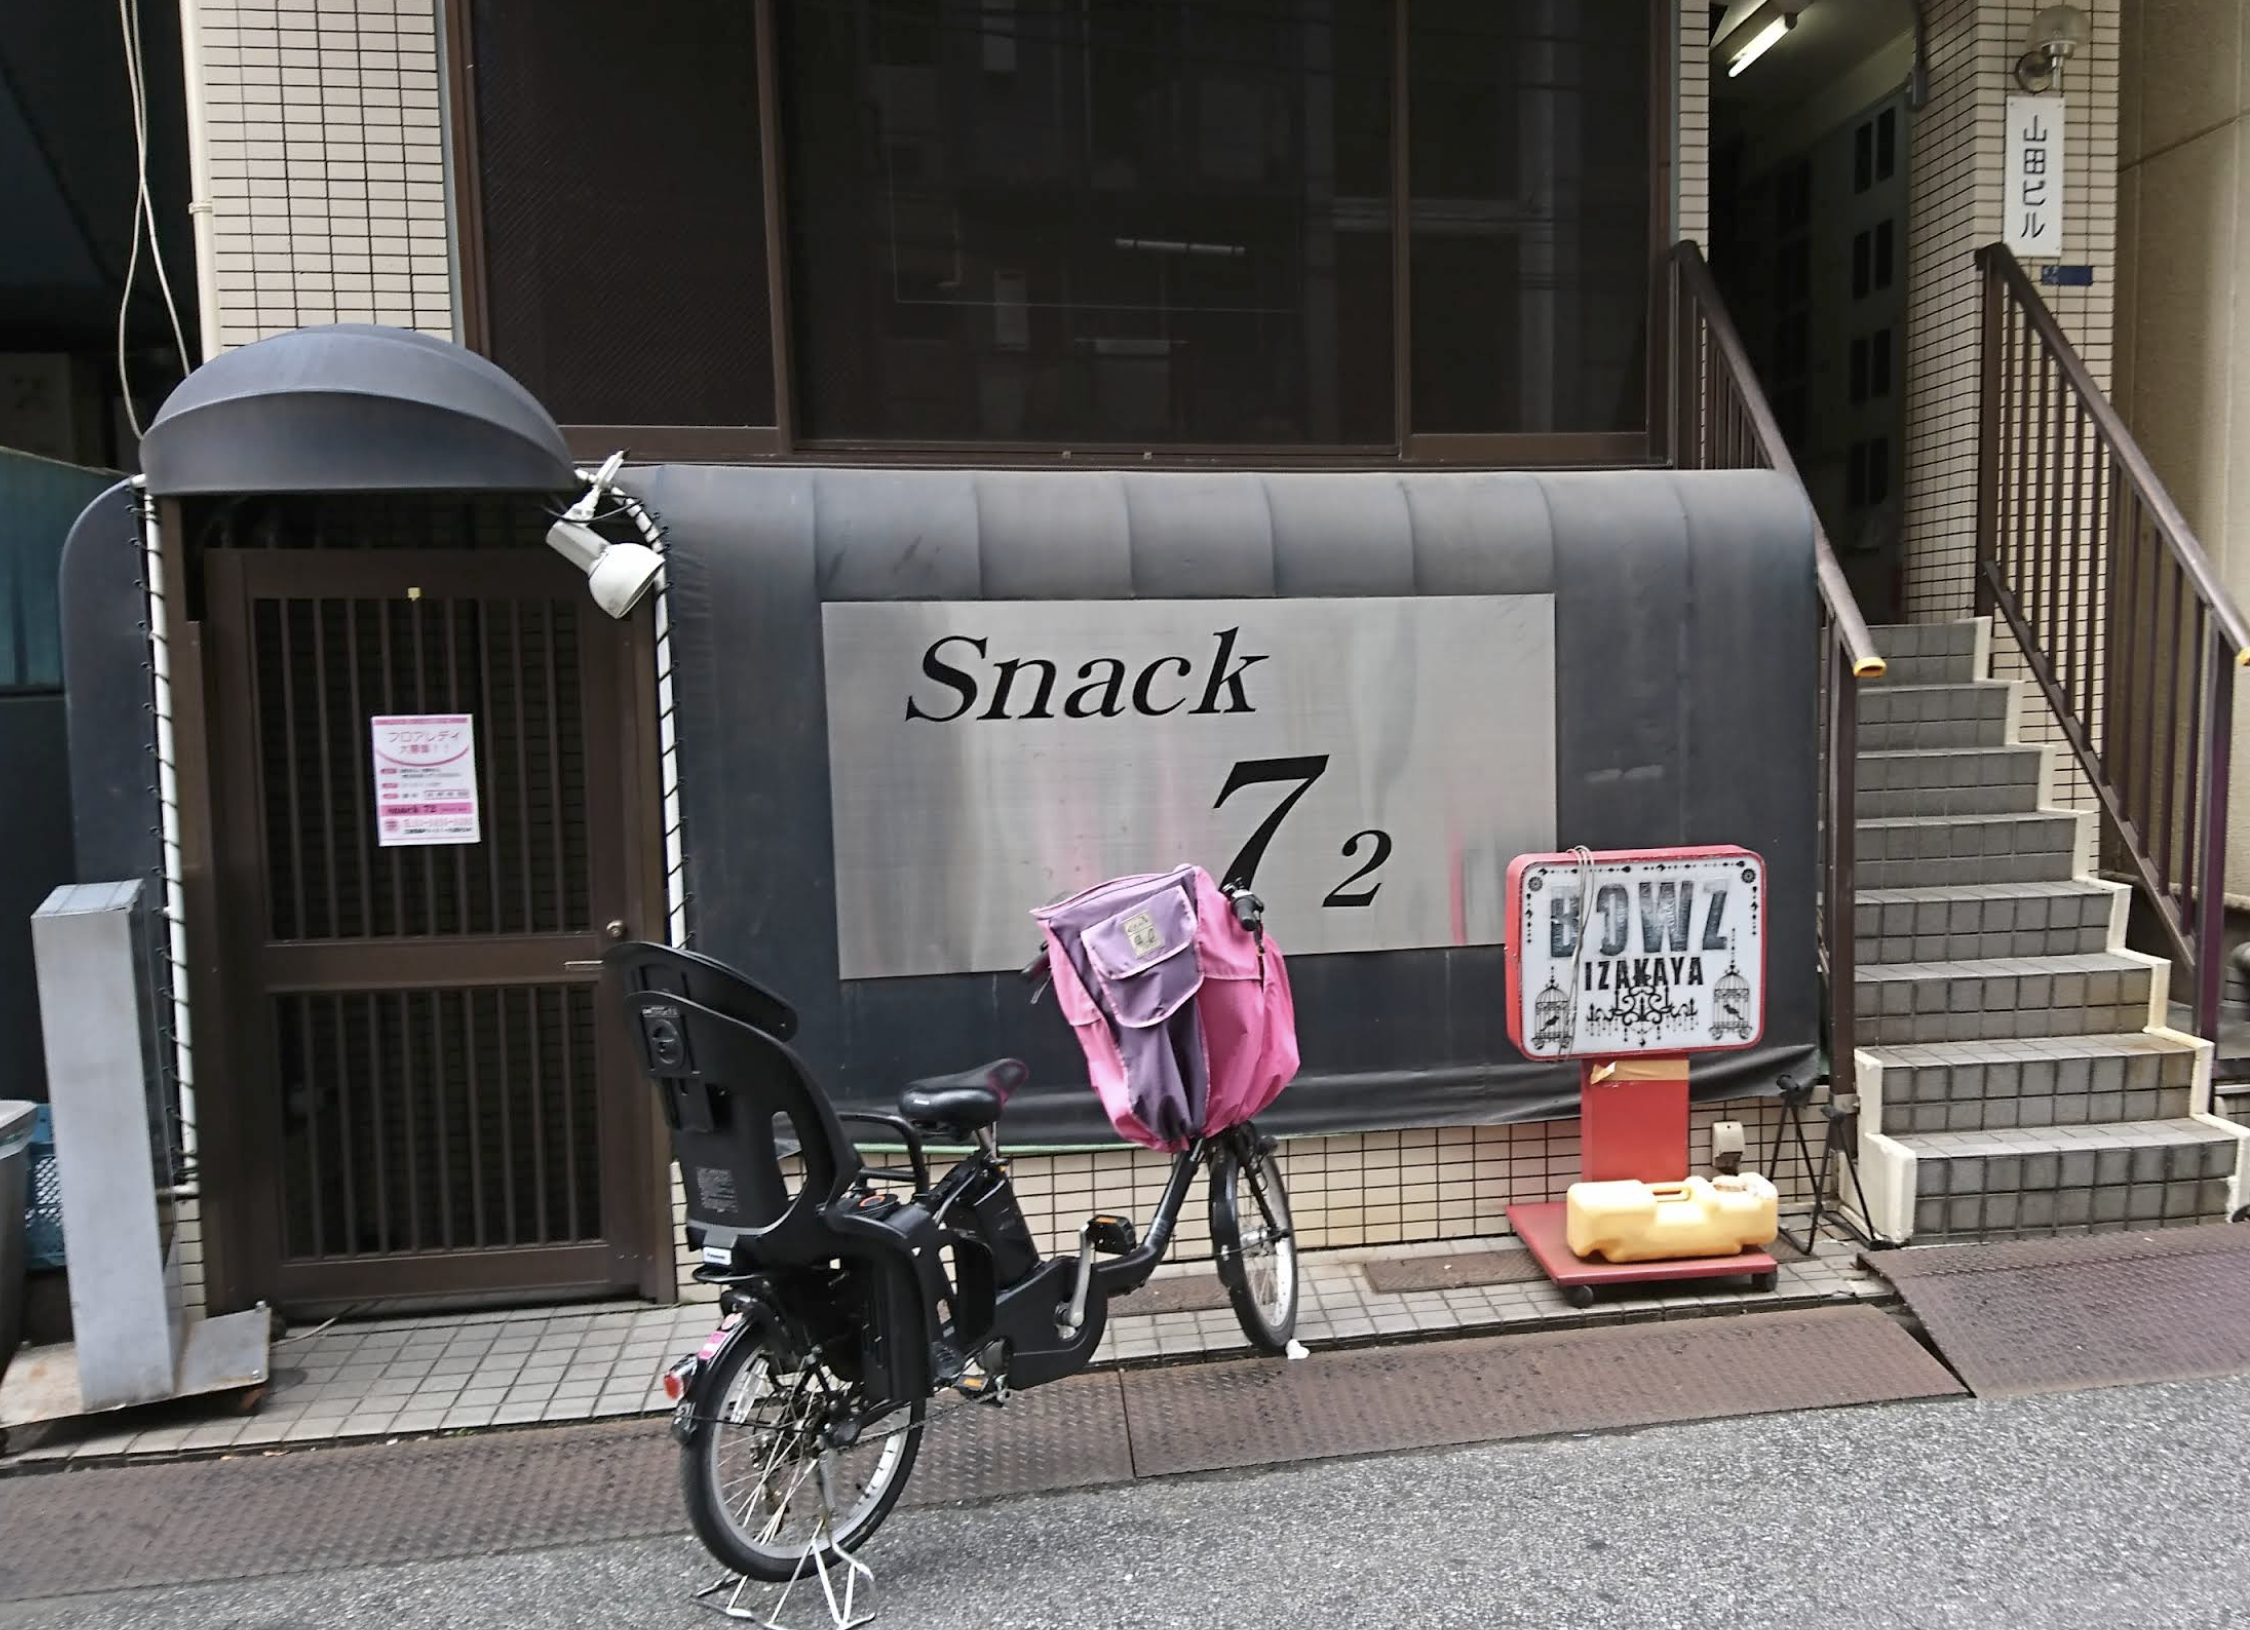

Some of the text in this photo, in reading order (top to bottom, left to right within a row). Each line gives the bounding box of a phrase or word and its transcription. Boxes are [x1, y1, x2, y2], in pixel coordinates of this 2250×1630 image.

[2021, 114, 2047, 239] 山田ビル
[905, 626, 1270, 722] Snack
[1584, 956, 1704, 991] IZAKAYA
